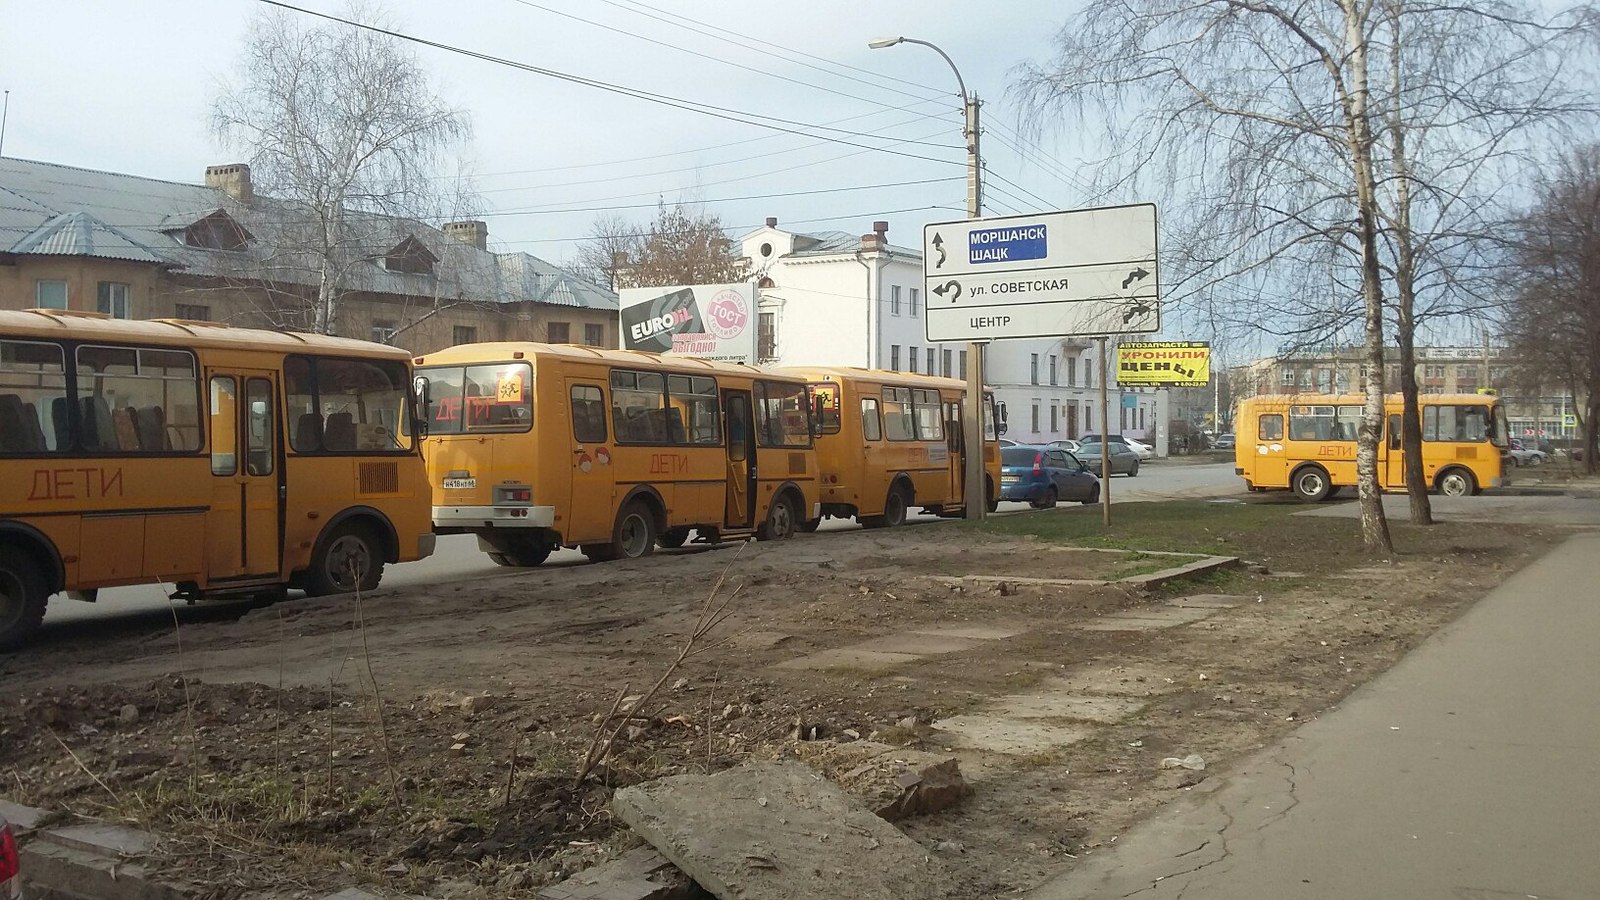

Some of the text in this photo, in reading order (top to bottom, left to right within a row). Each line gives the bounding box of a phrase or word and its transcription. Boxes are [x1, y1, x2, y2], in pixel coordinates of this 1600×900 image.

[970, 227, 1045, 244] МОРШАНСК
[970, 247, 1009, 262] ШАЦК
[970, 279, 1069, 298] ул. СОВЕТСКАЯ
[713, 304, 742, 324] ГОСТ
[970, 316, 1011, 330] ЦЕНТР
[673, 341, 717, 355] ВЫГОДНО!
[1121, 351, 1205, 360] УРОНИЛИ
[1121, 362, 1195, 378] ЦЕНЫ
[436, 397, 491, 420] ДЕТИ
[1318, 445, 1352, 456] ДЕТИ
[650, 454, 689, 473] ДЕТИ
[27, 467, 124, 501] ДЕТИ
